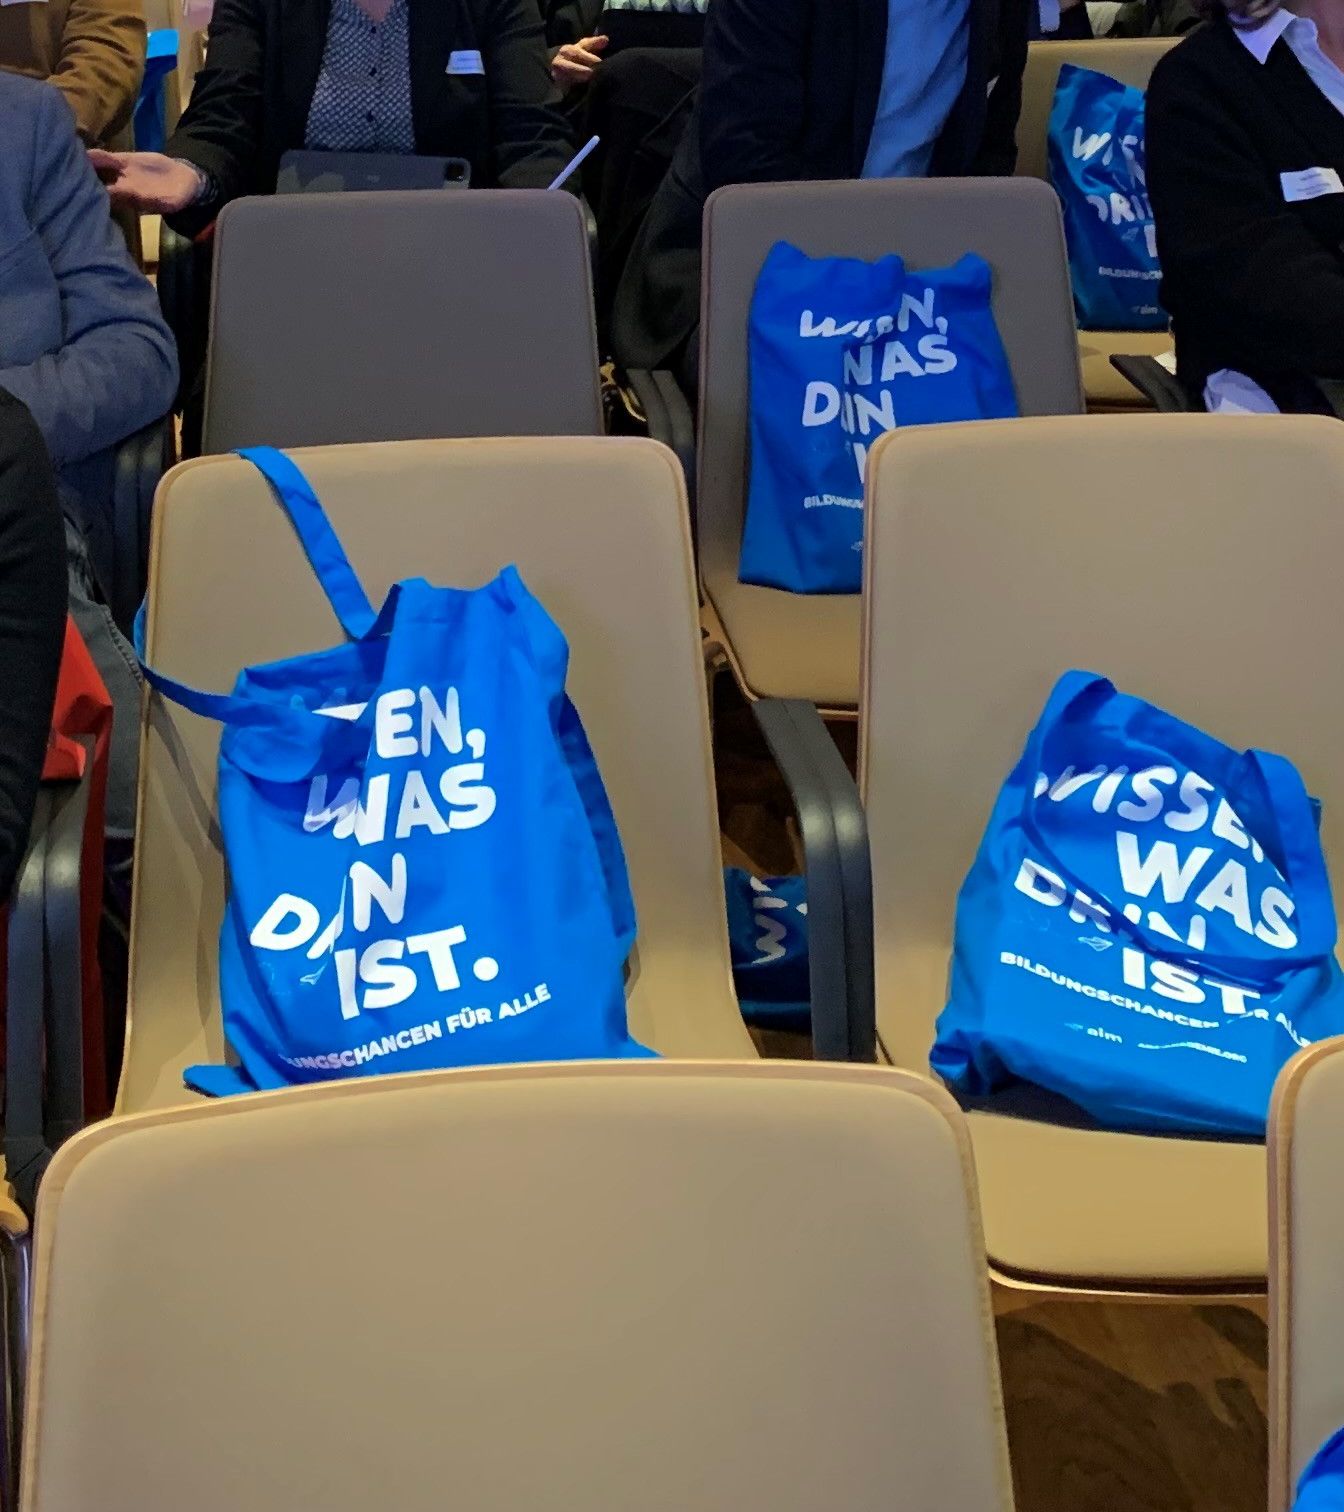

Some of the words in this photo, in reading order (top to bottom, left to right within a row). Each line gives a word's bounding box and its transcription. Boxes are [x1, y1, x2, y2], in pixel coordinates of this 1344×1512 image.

[1115, 830, 1299, 949] WAS
[336, 924, 500, 1020] IST.
[281, 1021, 442, 1070] UNGSCHANCEN
[447, 1006, 493, 1034] FÜR
[499, 983, 552, 1019] ALLE
